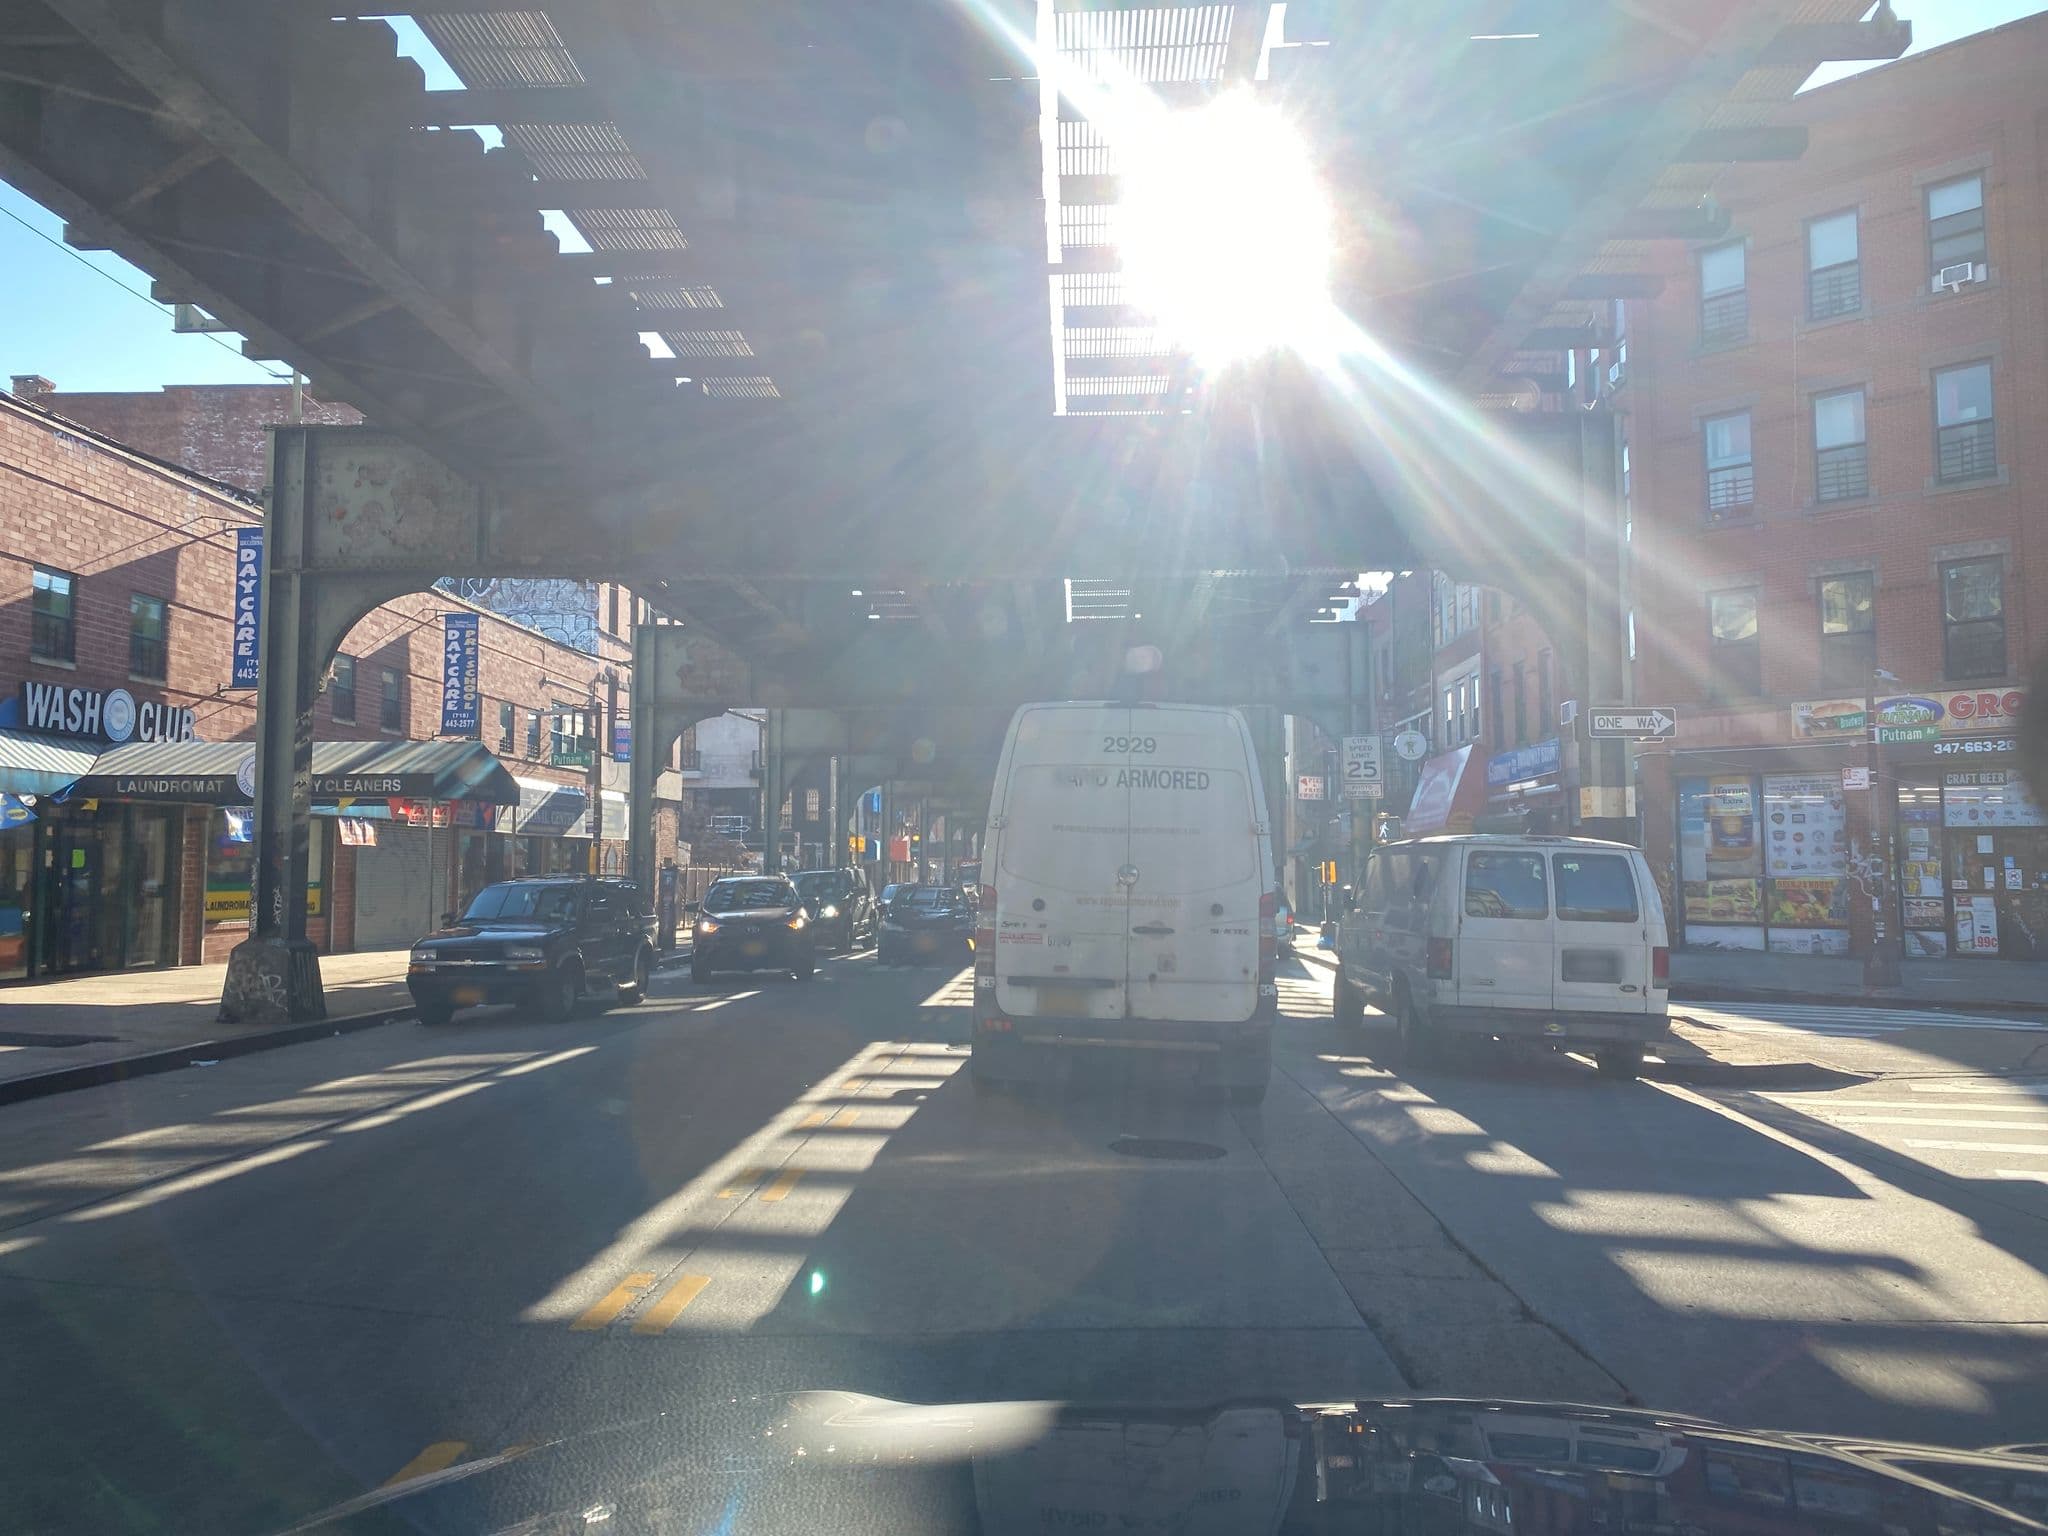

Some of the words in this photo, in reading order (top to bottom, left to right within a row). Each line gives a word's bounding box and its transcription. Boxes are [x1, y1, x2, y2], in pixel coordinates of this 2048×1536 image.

[236, 548, 258, 656] DAYCARE
[445, 629, 461, 711] DAYCARE
[25, 681, 101, 735] WASH
[139, 701, 196, 742] CLUB
[1876, 708, 1936, 725] PUTNAM
[445, 719, 475, 728] 443-2577
[1597, 717, 1623, 729] ONE
[1636, 717, 1664, 729] WAY
[1882, 728, 1923, 742] Putnam
[1103, 736, 1157, 754] 2929
[553, 754, 582, 765] Putnam
[1347, 761, 1378, 778] 25
[116, 780, 224, 793] LAUNDROMAT
[325, 779, 401, 792] CLEANERS
[1116, 769, 1210, 790] ARMORED
[1946, 774, 1976, 785] CRAFT
[1980, 773, 2004, 784] BEER
